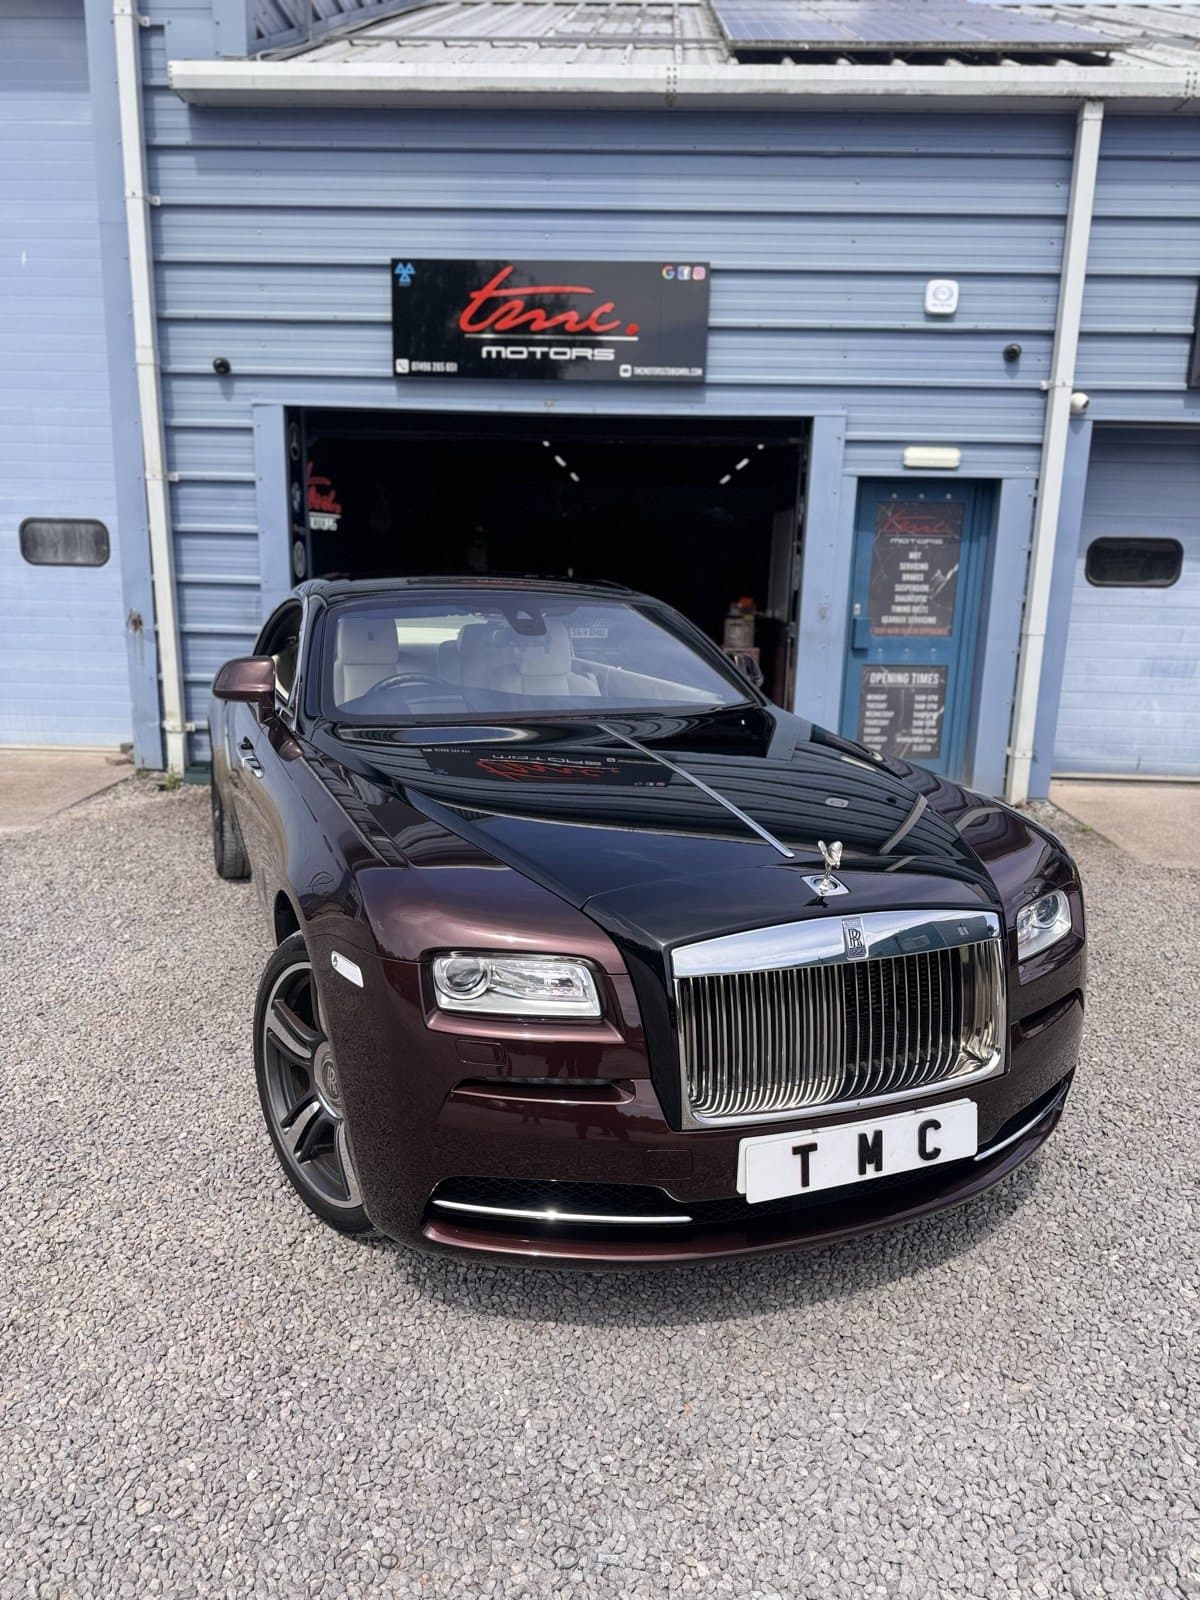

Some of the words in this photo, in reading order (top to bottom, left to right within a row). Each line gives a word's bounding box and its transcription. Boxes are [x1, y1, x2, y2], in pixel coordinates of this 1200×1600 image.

[482, 346, 615, 361] MOTORS
[869, 672, 910, 685] OPENING
[912, 672, 940, 685] TIMES
[791, 1142, 818, 1188] T
[858, 1129, 884, 1176] M
[917, 1118, 943, 1162] C
